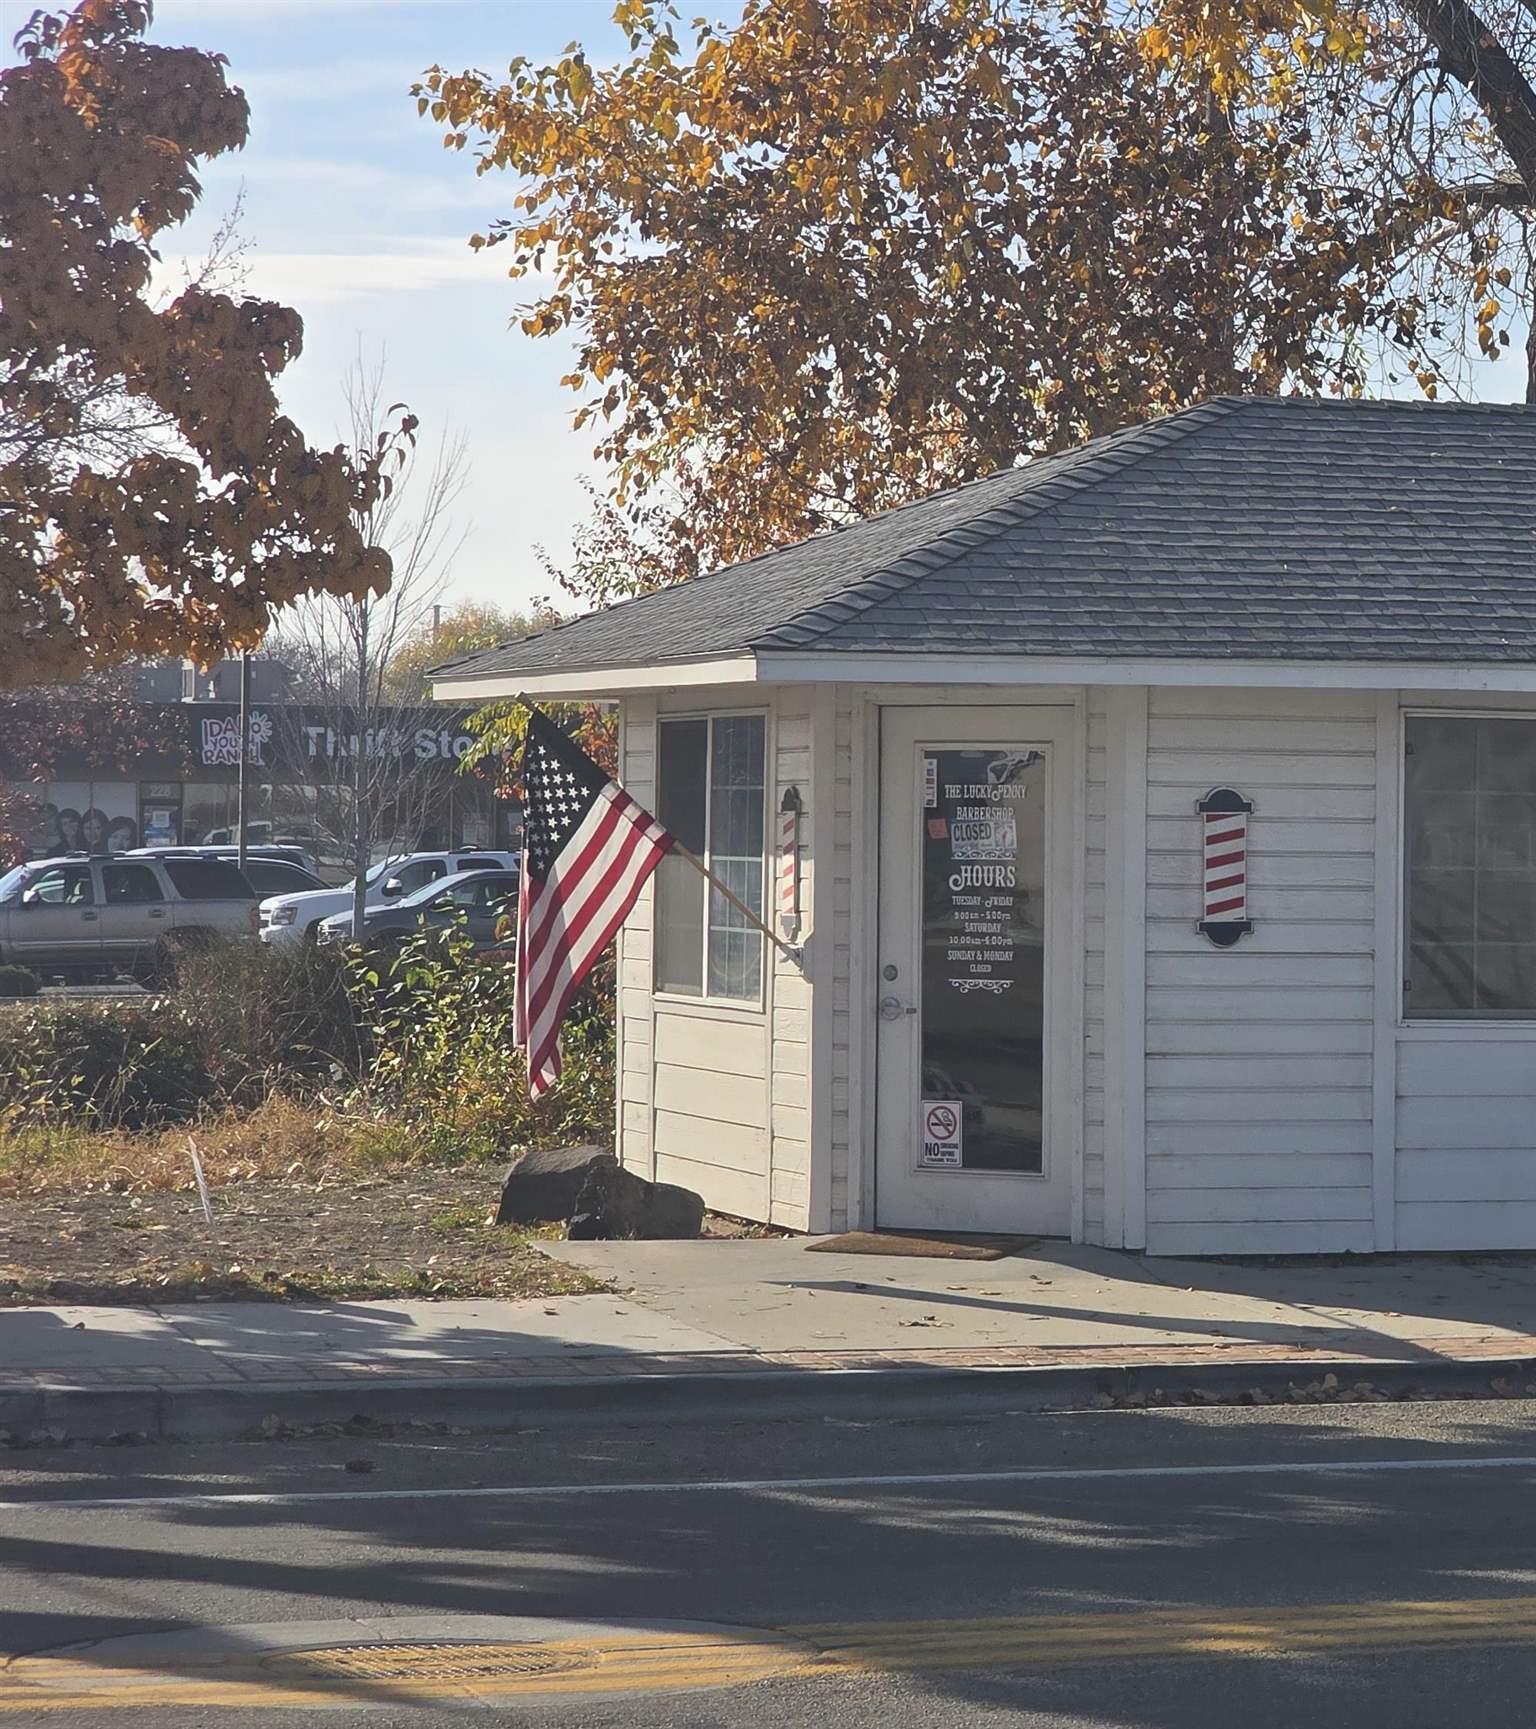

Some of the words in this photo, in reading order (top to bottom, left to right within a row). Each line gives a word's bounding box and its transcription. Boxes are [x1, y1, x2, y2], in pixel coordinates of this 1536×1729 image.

[944, 784, 961, 799] THE
[964, 784, 992, 799] LUCKY
[992, 784, 1026, 801] PENNY
[956, 806, 1015, 820] BARBERSHOP
[953, 822, 992, 842] CLOSED
[948, 865, 1016, 891] HOURS
[952, 896, 981, 905] TUESDAY
[965, 922, 1001, 933] SATURDAY
[947, 950, 975, 961] SUNDAY
[976, 951, 983, 961] &
[984, 951, 1013, 961] MONDAY
[925, 1142, 940, 1157] NO
